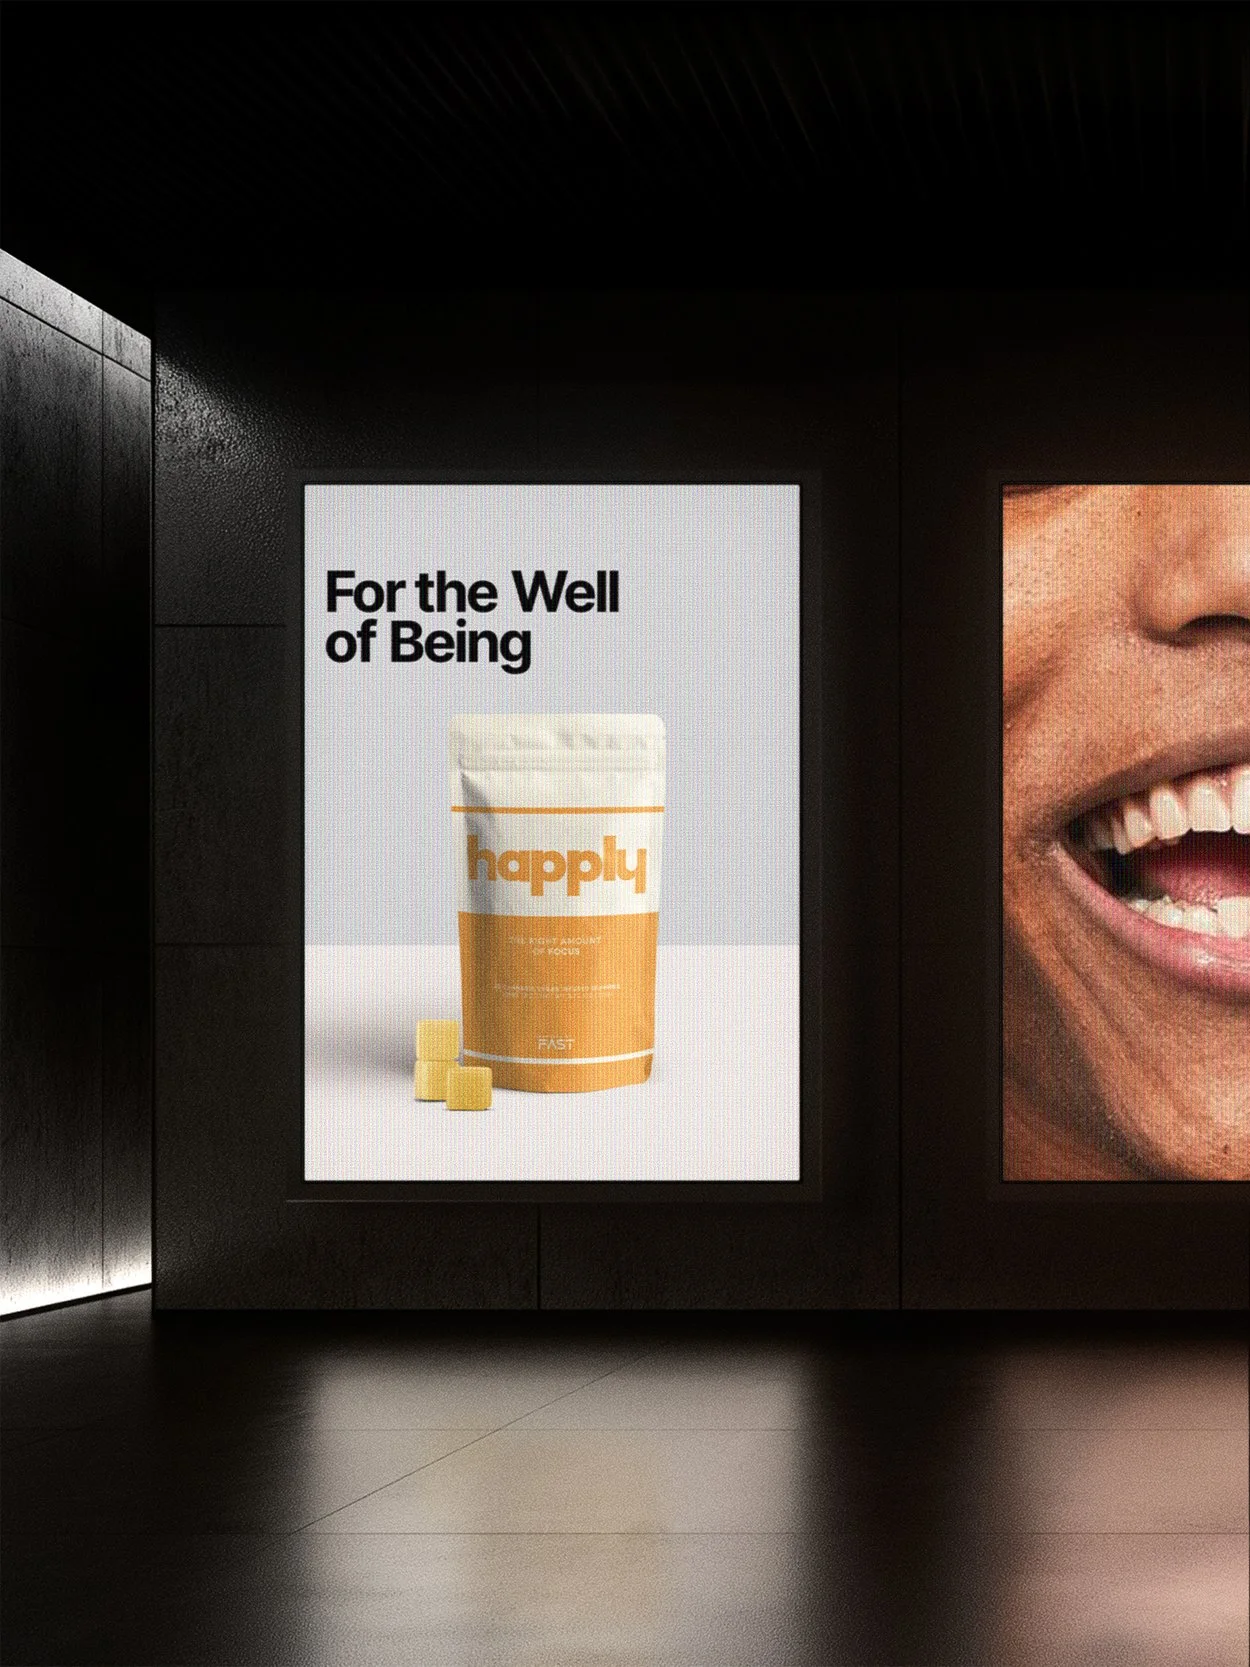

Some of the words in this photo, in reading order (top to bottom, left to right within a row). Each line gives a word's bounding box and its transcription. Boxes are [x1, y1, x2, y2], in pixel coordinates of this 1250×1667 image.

[326, 569, 406, 613] For
[415, 570, 498, 613] the
[511, 569, 620, 613] Well
[325, 619, 378, 663] of
[391, 619, 532, 675] Being
[467, 834, 648, 897] happly
[547, 947, 580, 956] FOCUS
[538, 1038, 575, 1051] FAST
